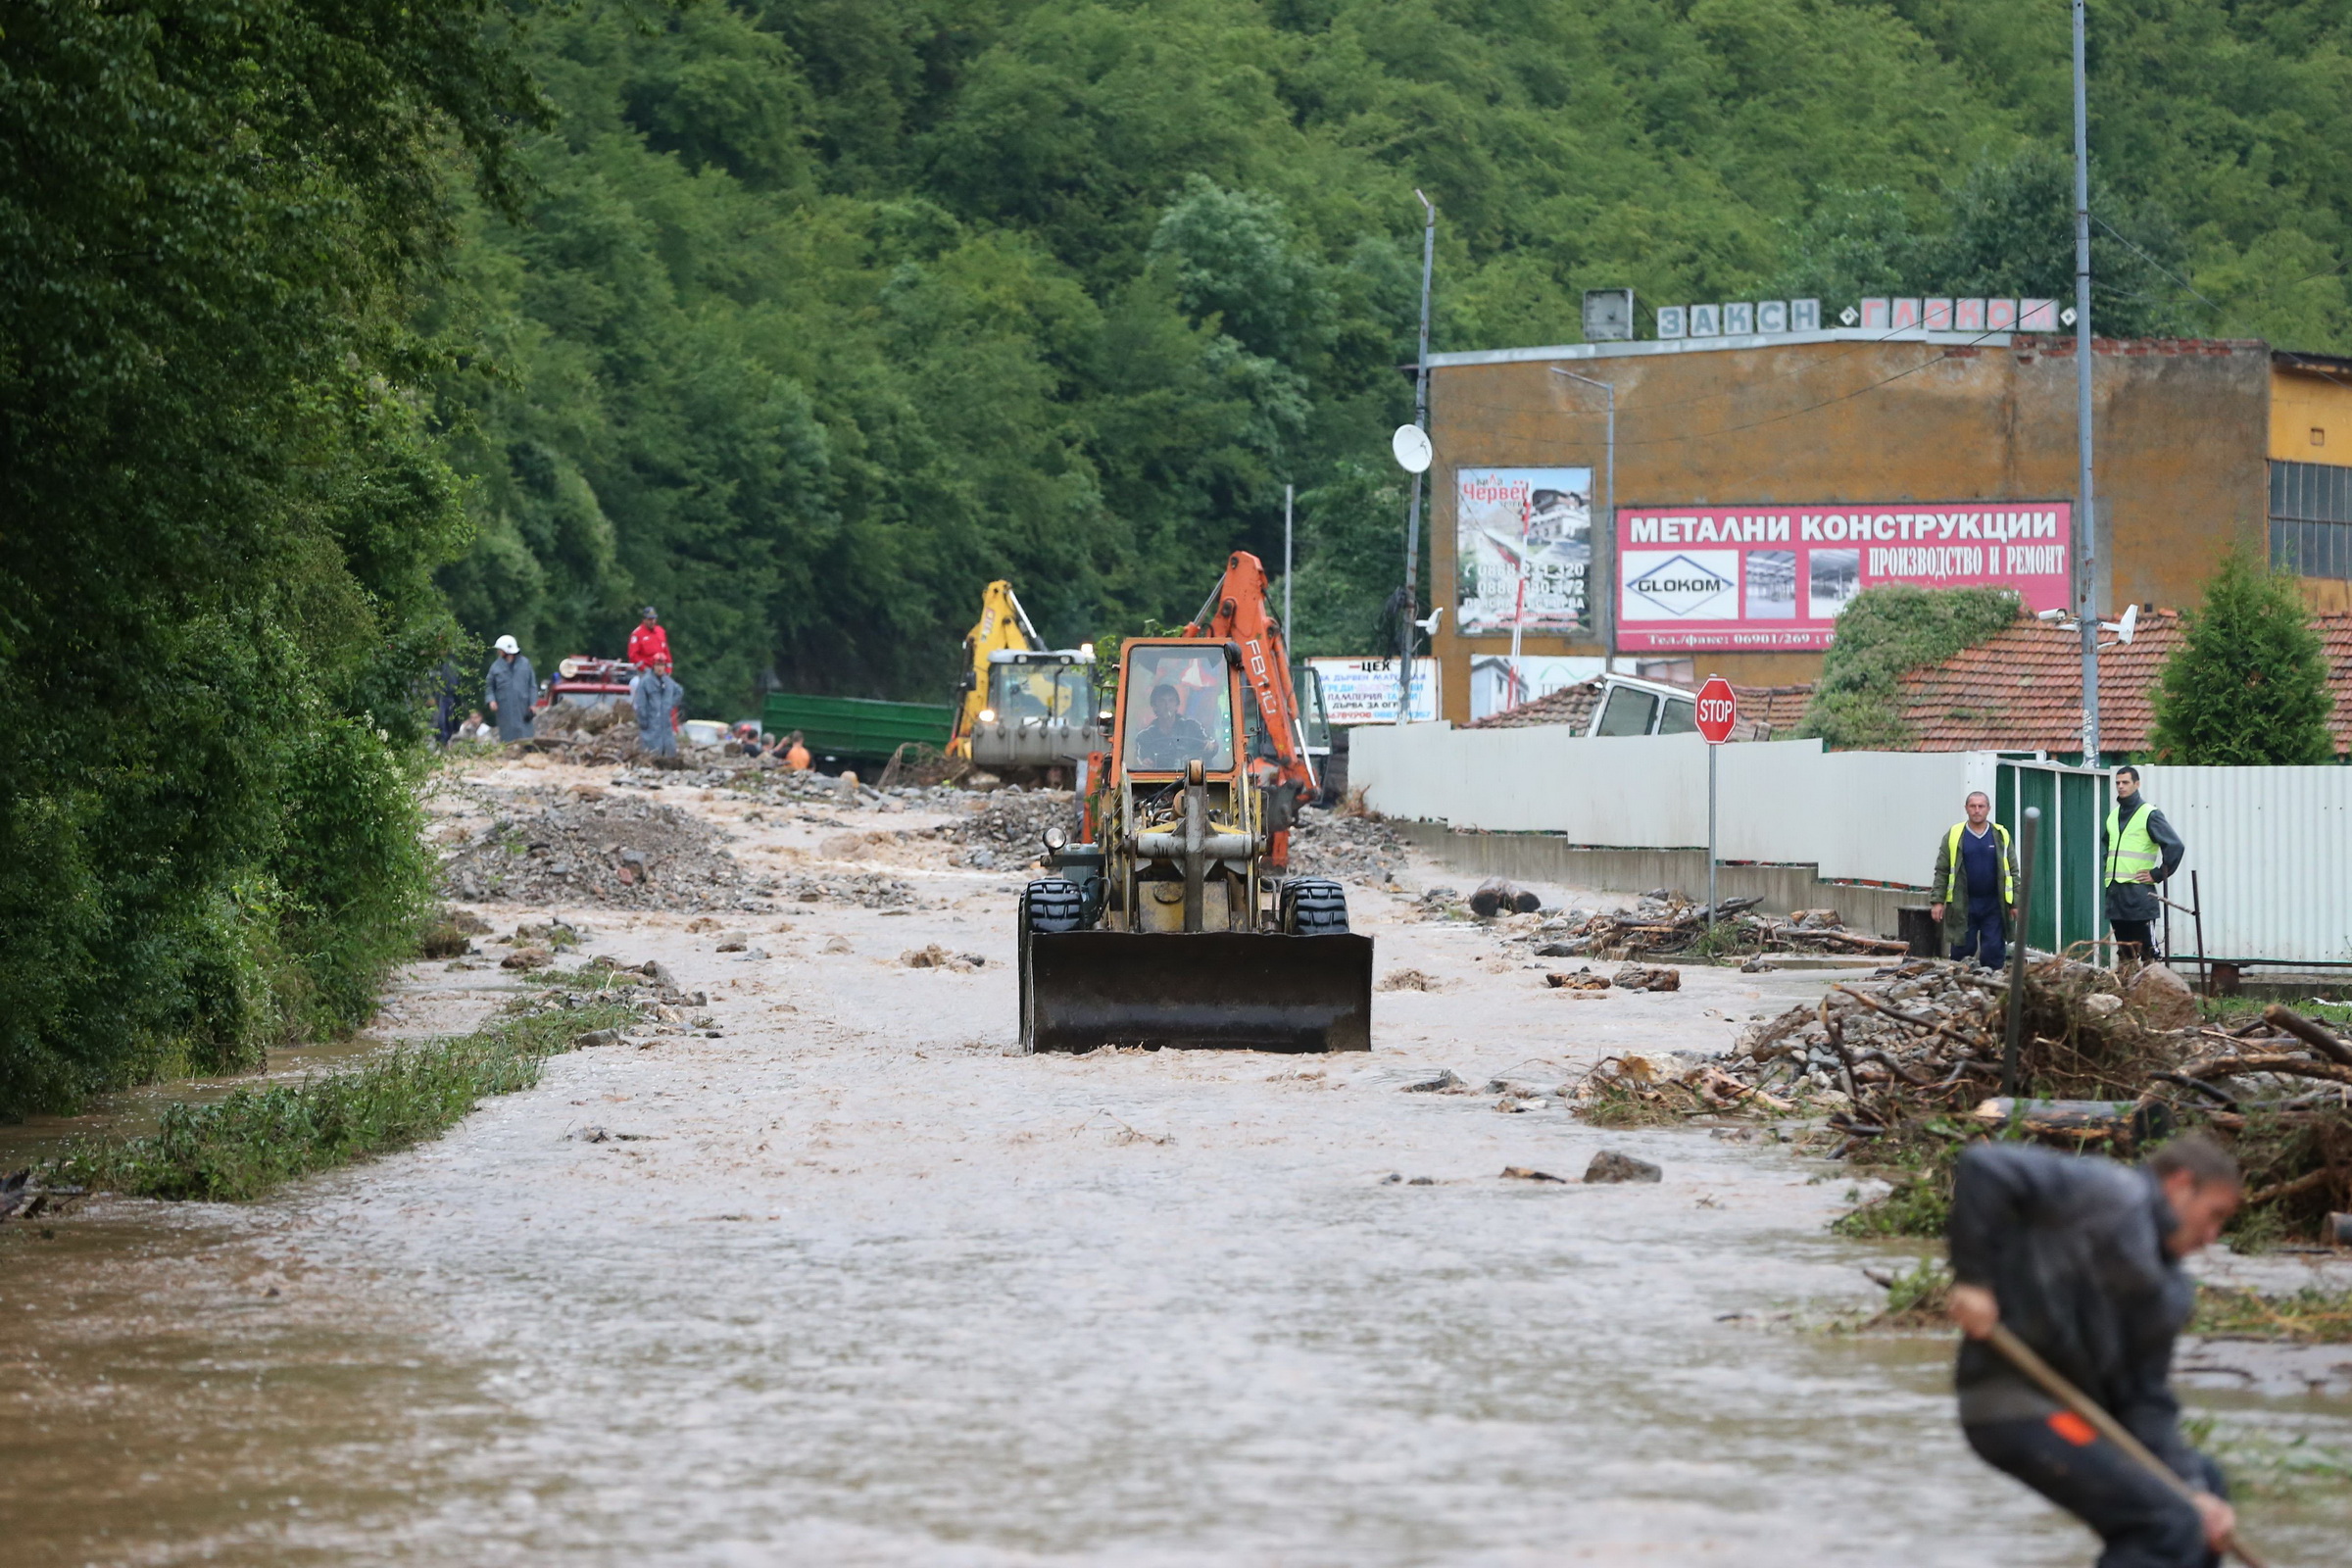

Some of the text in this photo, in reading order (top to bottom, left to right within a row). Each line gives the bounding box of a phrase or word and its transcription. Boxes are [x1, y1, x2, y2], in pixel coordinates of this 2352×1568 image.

[1865, 301, 2052, 328] ГЛОКОМ
[1630, 511, 2056, 543] МЕТАЛНИ КОНСТРУКЦИИ
[1868, 544, 2065, 580] ПРОИЗВОДСТВО И РЕМОНТ
[1638, 579, 1721, 593] GLOKOM
[1734, 633, 1810, 645] 06901/269
[1362, 661, 1391, 672] ЦЕХ
[1699, 699, 1733, 723] STOP
